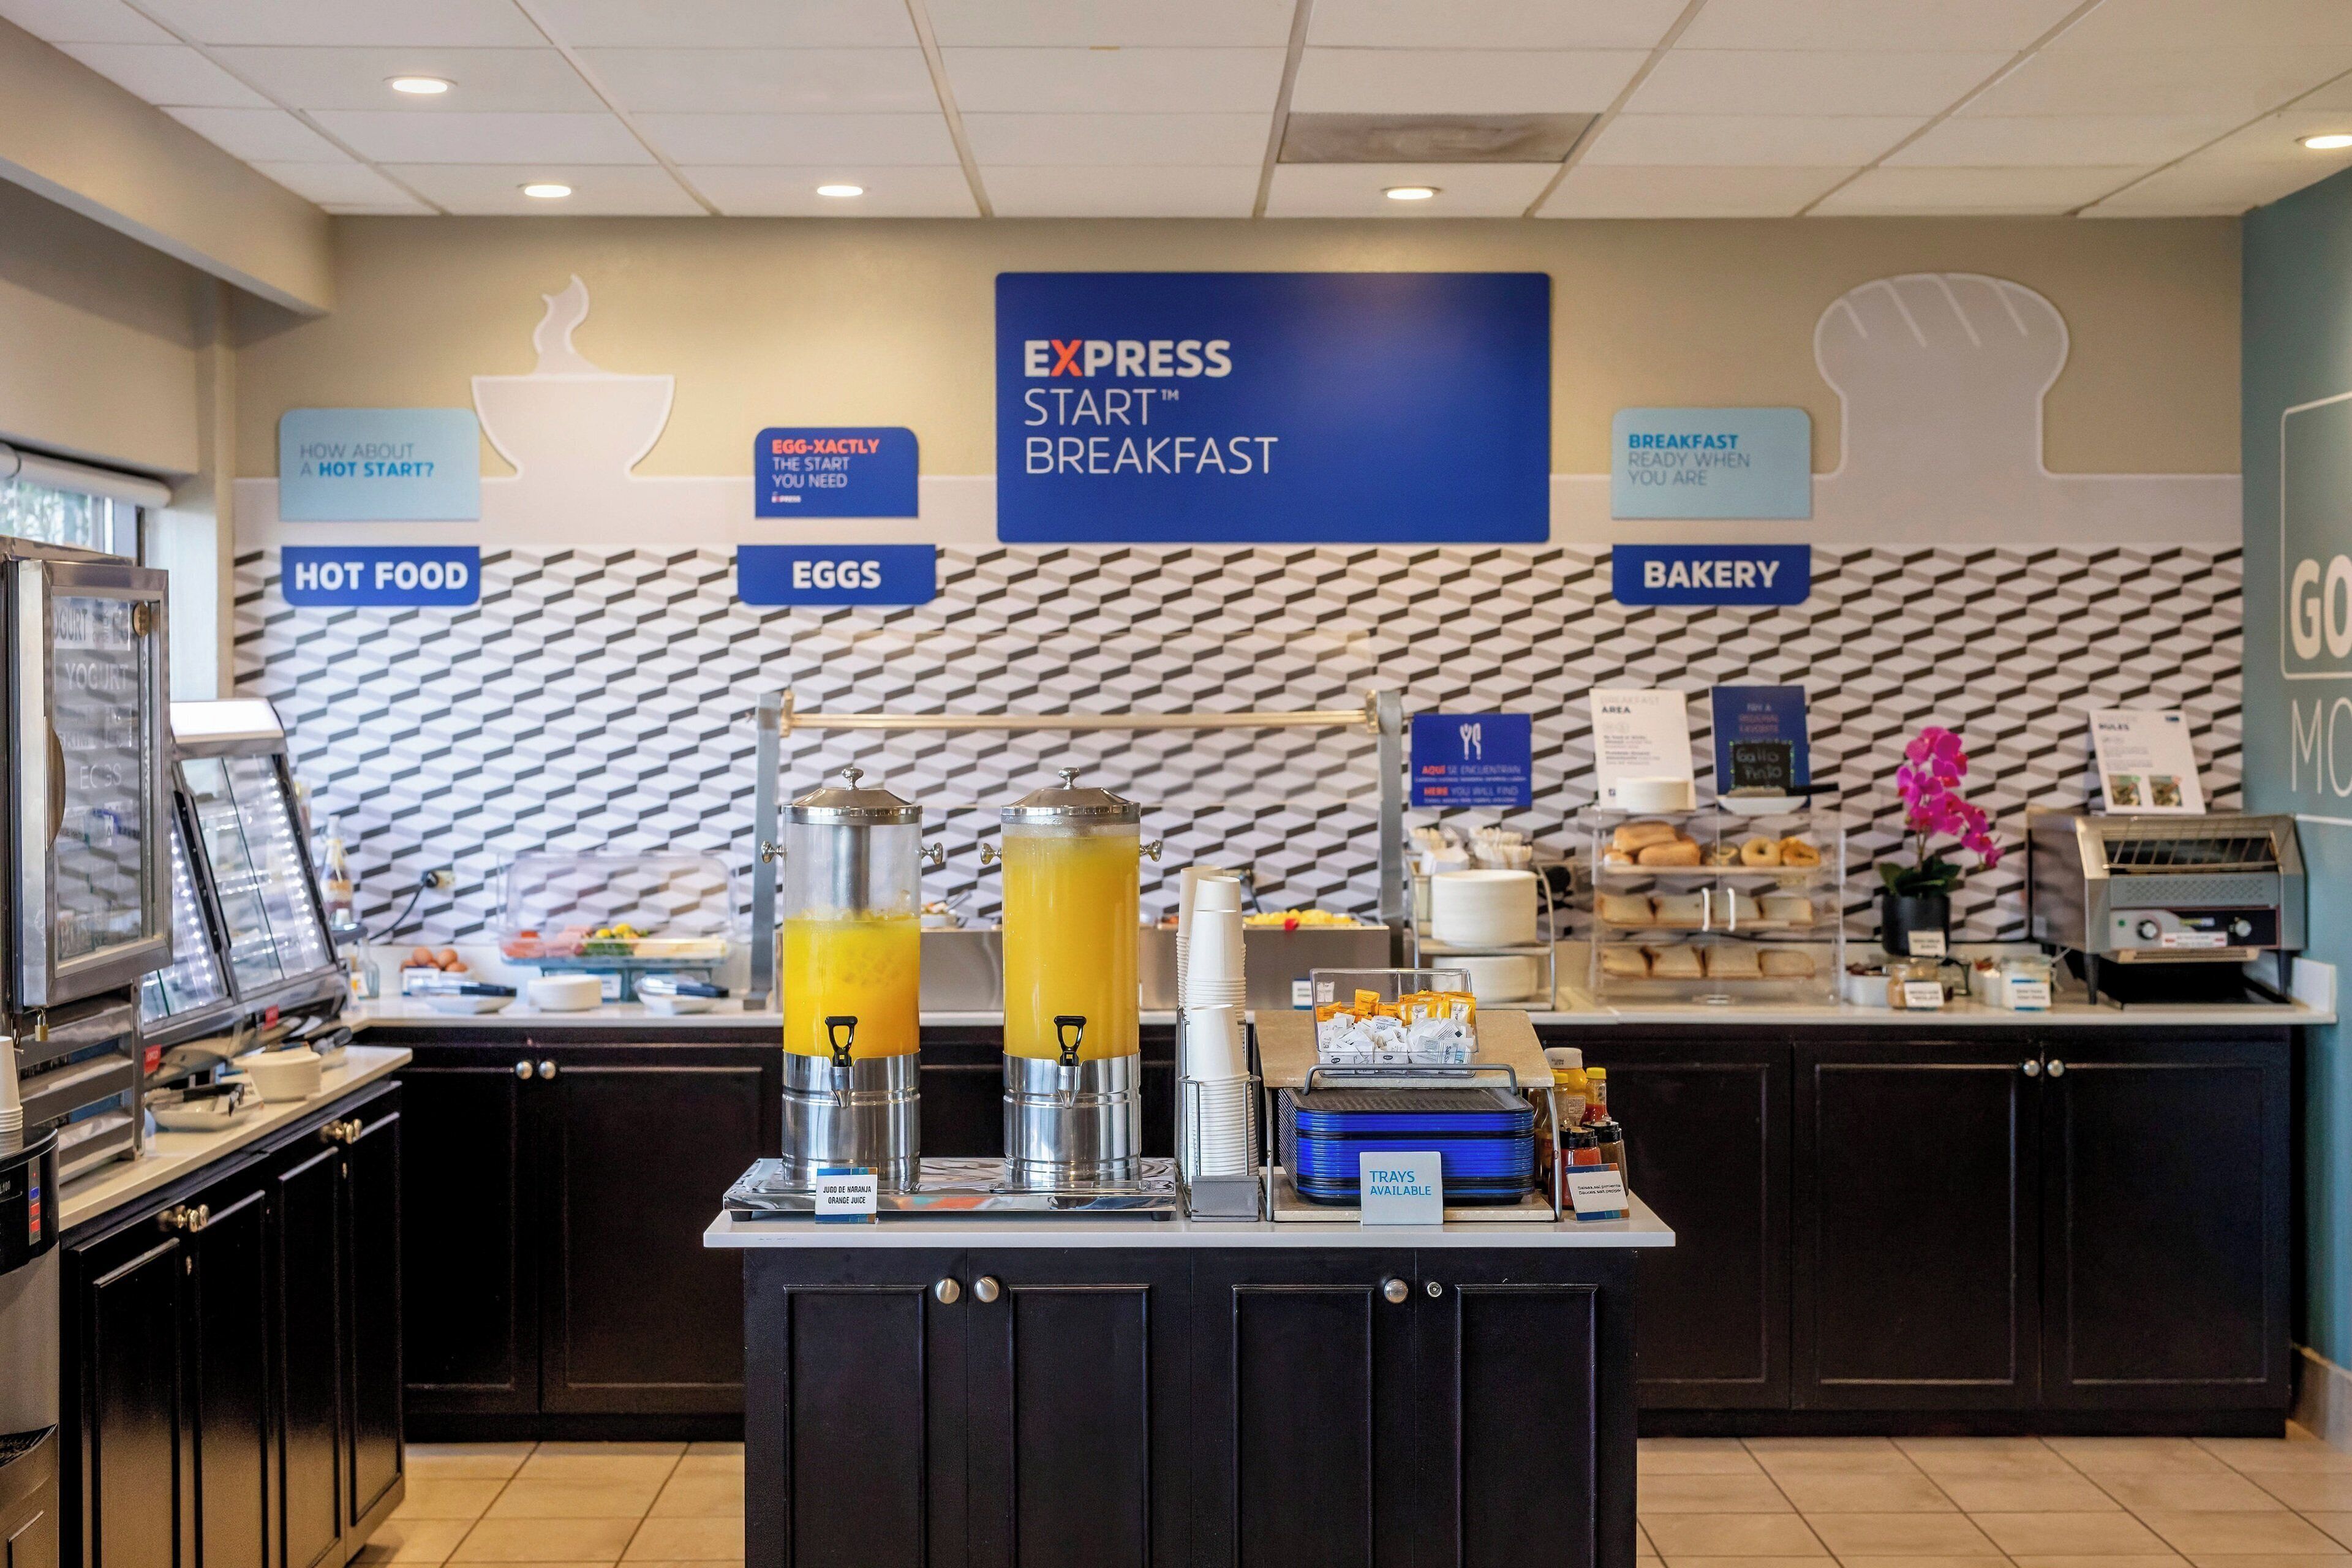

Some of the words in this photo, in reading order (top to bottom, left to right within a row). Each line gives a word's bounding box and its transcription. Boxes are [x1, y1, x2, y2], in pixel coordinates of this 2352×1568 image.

[1025, 339, 1232, 378] EXPRESS
[300, 442, 345, 459] HOW
[352, 442, 414, 459] ABOUT
[772, 439, 880, 454] EGG-XACTLY
[1629, 434, 1739, 450] BREAKFAST
[772, 457, 800, 471] THE
[804, 457, 850, 471] START
[1026, 437, 1279, 475] BREAKFAST
[1629, 451, 1688, 468] READY
[1694, 452, 1751, 469] WHEN
[301, 463, 312, 477] A
[319, 462, 356, 477] HOT
[364, 462, 434, 477] START?
[1628, 469, 1667, 486] YOU
[1673, 470, 1707, 486] ARE
[772, 473, 804, 488] YOU
[809, 473, 848, 488] NEED
[295, 562, 364, 590] HOT
[375, 560, 468, 590] FOOD
[793, 560, 882, 589] EGGS
[1644, 561, 1780, 589] BAKERY
[1370, 1170, 1415, 1183] TRAYS
[1370, 1186, 1431, 1196] AVAILABLE
